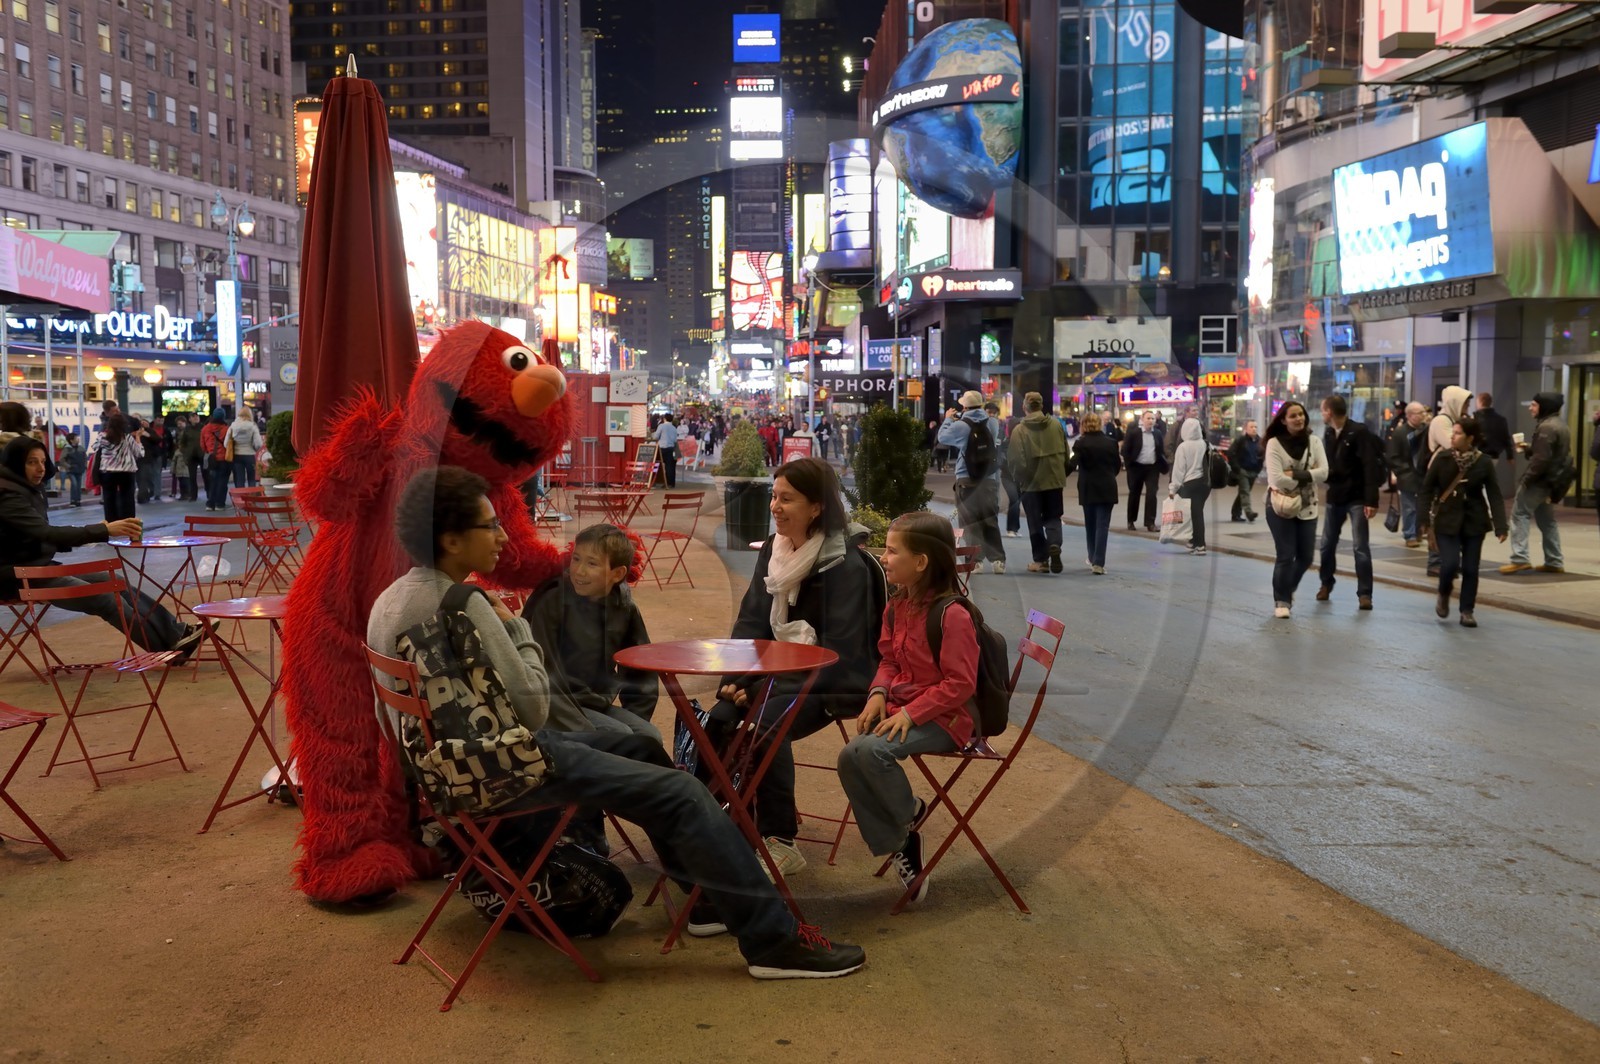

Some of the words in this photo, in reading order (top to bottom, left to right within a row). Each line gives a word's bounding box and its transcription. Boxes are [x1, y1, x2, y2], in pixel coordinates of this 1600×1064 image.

[581, 51, 593, 120] TIMES
[702, 187, 711, 249] NOVOTEL
[13, 237, 101, 298] Walgreens
[94, 311, 152, 339] POLICE
[154, 305, 193, 340] DEPT
[1088, 338, 1135, 353] 1500
[1148, 387, 1193, 401] DOG
